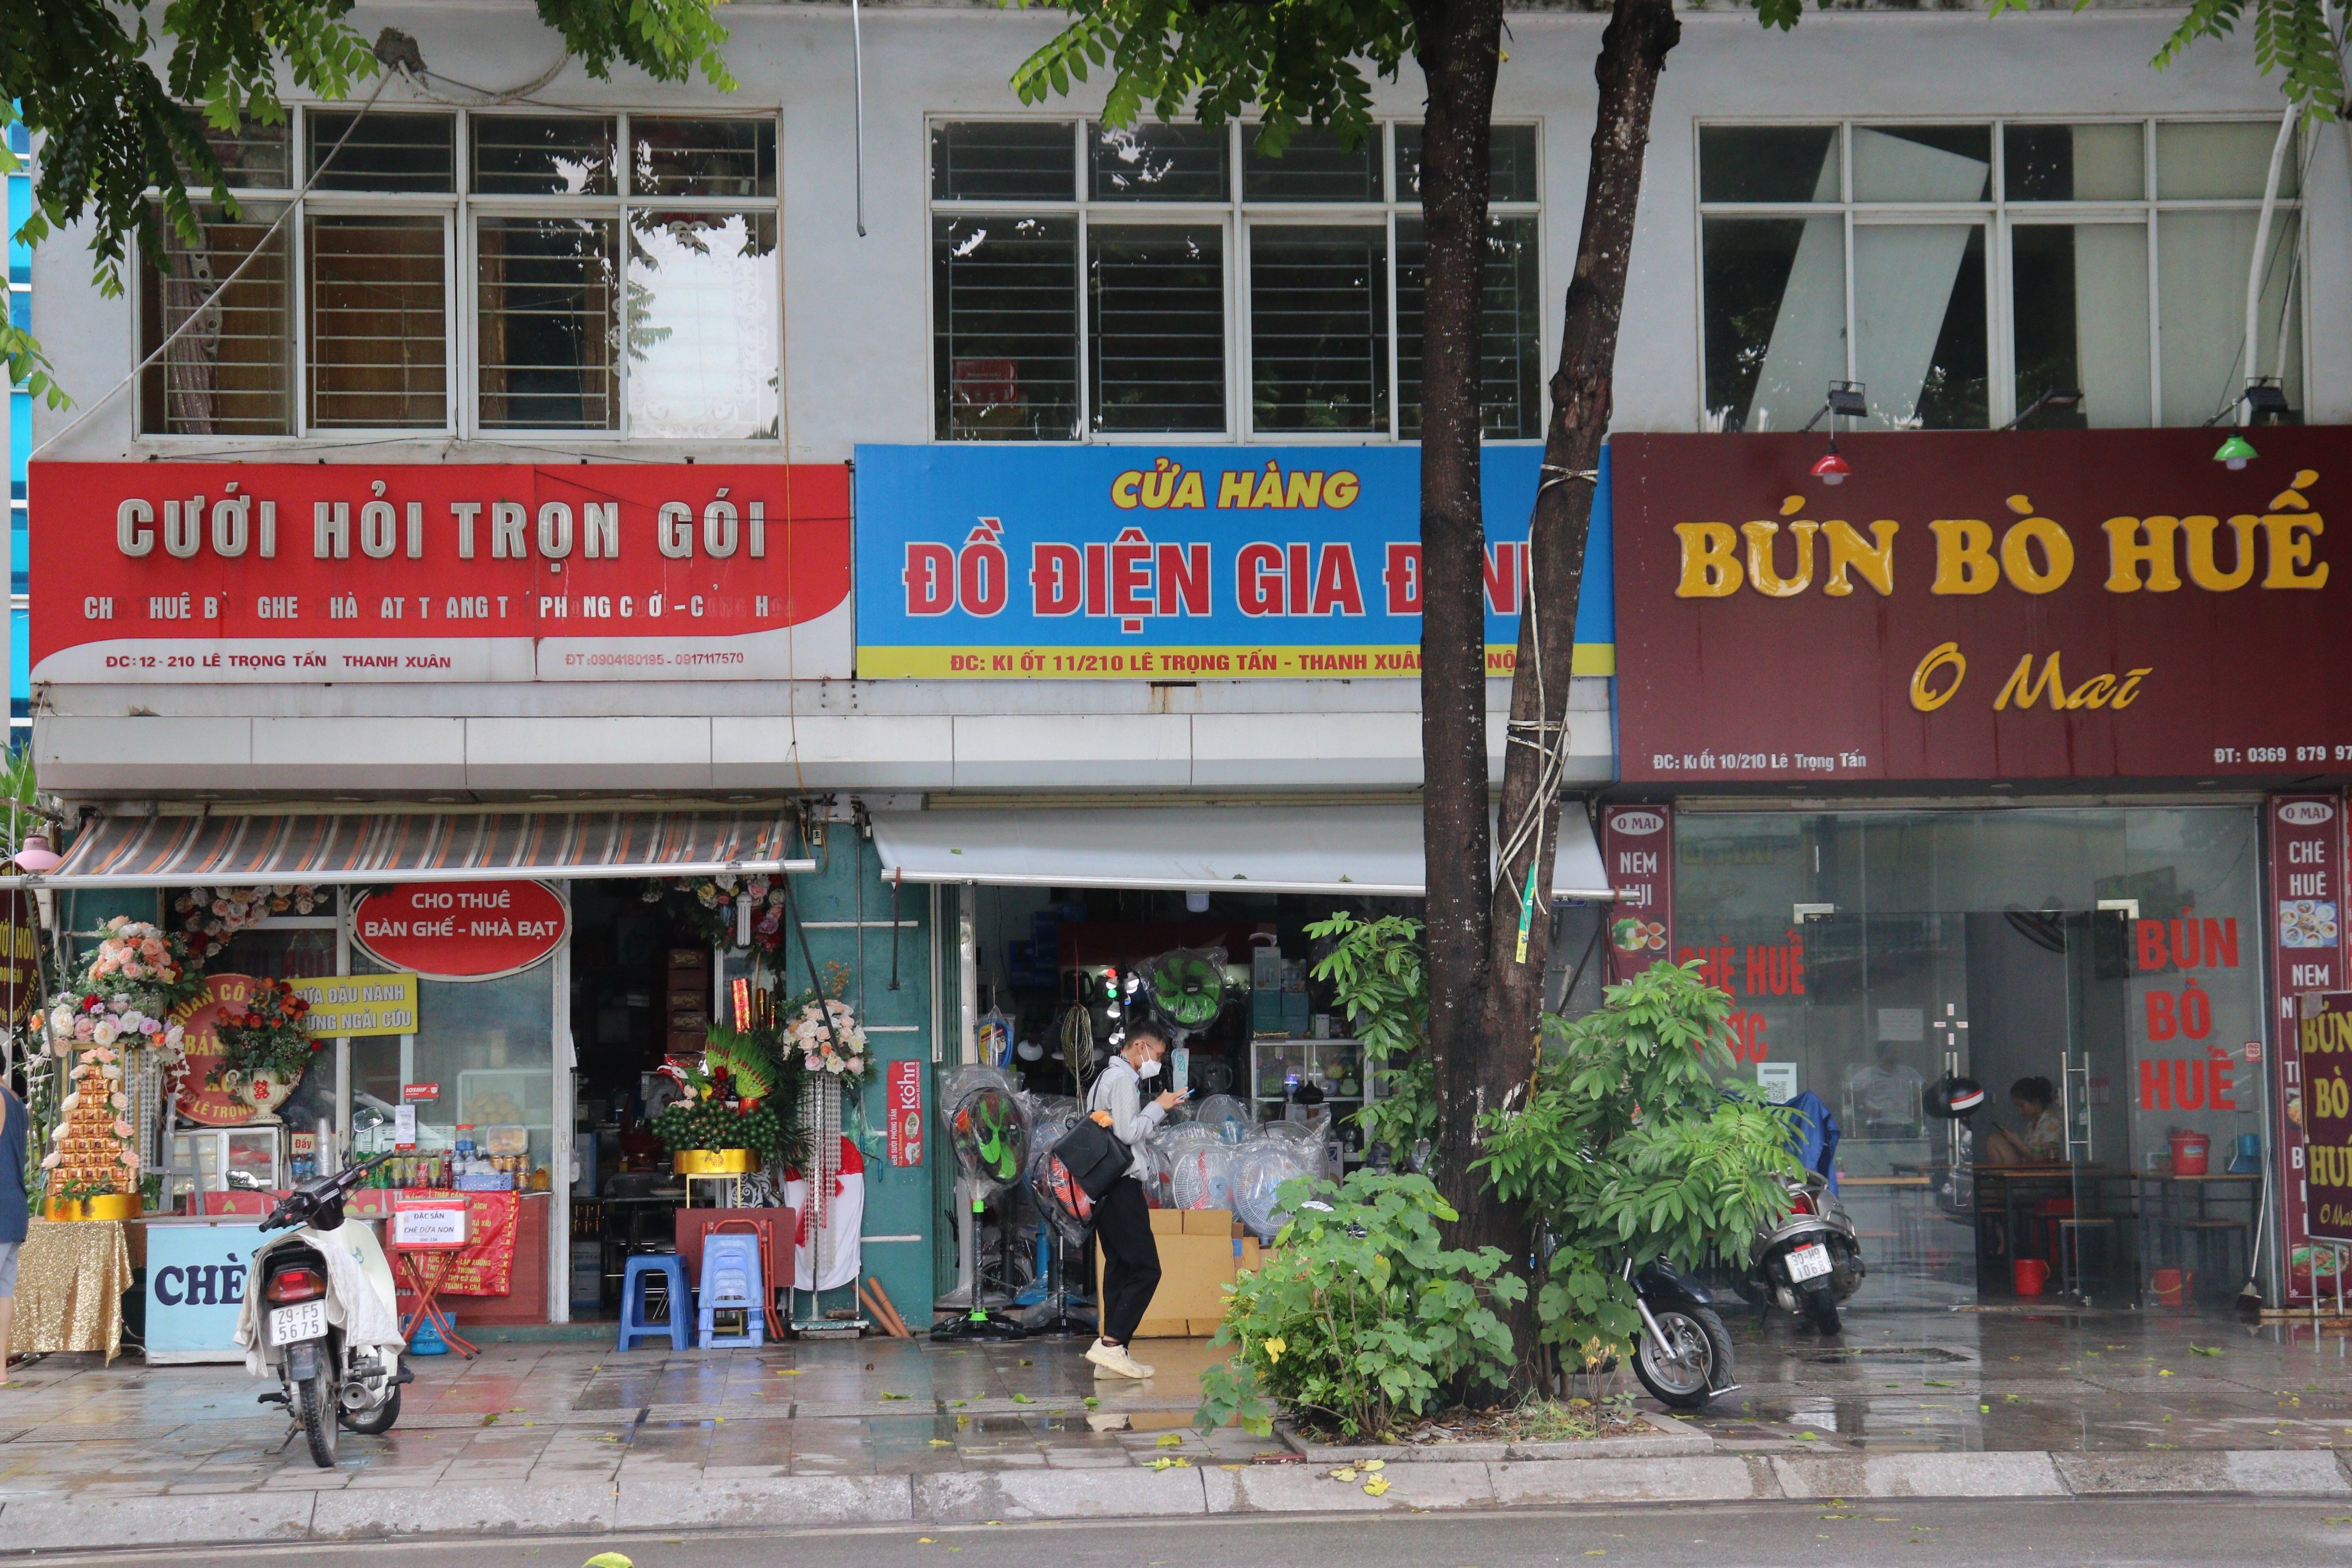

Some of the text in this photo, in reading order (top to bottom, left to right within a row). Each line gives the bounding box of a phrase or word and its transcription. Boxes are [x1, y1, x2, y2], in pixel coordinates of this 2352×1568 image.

[1111, 456, 1361, 509] CỬA HÀNG
[117, 480, 764, 573] CƯỚI HỎI TRỌN GÓI
[1673, 469, 2329, 597] BÚN BÒ HUẾ
[902, 516, 1008, 617] ĐỒ
[1029, 526, 1212, 634] ĐIỆN
[1235, 542, 1366, 617] GIA
[168, 655, 195, 667] 210
[203, 653, 221, 666] LÊ
[229, 655, 285, 670] TRỌNG
[293, 651, 326, 667] TẤN
[342, 655, 398, 667] THANH
[405, 654, 451, 668] XUÂN
[675, 652, 744, 665] 0917117570
[950, 655, 985, 671] ĐC:
[992, 655, 1013, 671] KI
[1021, 650, 1045, 671] ỐT
[1053, 654, 1123, 671] 11/210
[1130, 652, 1153, 671] LÊ
[1161, 654, 1230, 674] TRỌNG
[1236, 648, 1277, 670] TẤN
[1299, 654, 1368, 670] THANH
[1374, 651, 1422, 670] XUÂ
[1910, 642, 2153, 712] O Mai
[1654, 754, 1679, 769] ĐC:
[1700, 748, 1716, 769] Ốt
[1720, 753, 1767, 770] 10/210
[1772, 753, 1789, 768] Lê
[1794, 753, 1835, 771] Trọng
[1840, 748, 1867, 767] Tấn
[2214, 748, 2241, 763] ĐT:
[2247, 747, 2287, 762] 0369
[2296, 746, 2327, 761] 879
[1618, 817, 1657, 829] O MAI
[2286, 808, 2326, 819] O MAI
[1620, 851, 1658, 874] NEM
[2289, 838, 2325, 864] CHÈ
[412, 889, 511, 909] CHO THUÊ
[365, 918, 407, 937] BÀN
[412, 915, 453, 937] GHẾ
[471, 917, 513, 936] NHÀ
[518, 921, 557, 940] BẠT
[2135, 907, 2239, 970] BÚN
[1746, 929, 1805, 995] HUẾ
[2292, 964, 2330, 986] NEM
[328, 984, 358, 1005] ĐẬU
[362, 982, 404, 1002] NÀNH
[381, 1008, 412, 1028] CỨU
[2146, 978, 2212, 1041] BÒ
[897, 1062, 916, 1109] Köhn
[2140, 1045, 2237, 1110] HUẾ
[2315, 1065, 2349, 1119] BÒ
[193, 1101, 210, 1115] LÊ
[295, 1137, 311, 1150] Đẩy
[414, 1212, 428, 1221] ĐẶC
[154, 1253, 245, 1306] CHÈ
[278, 1303, 318, 1325] 29-F5
[279, 1320, 319, 1341] 5675
